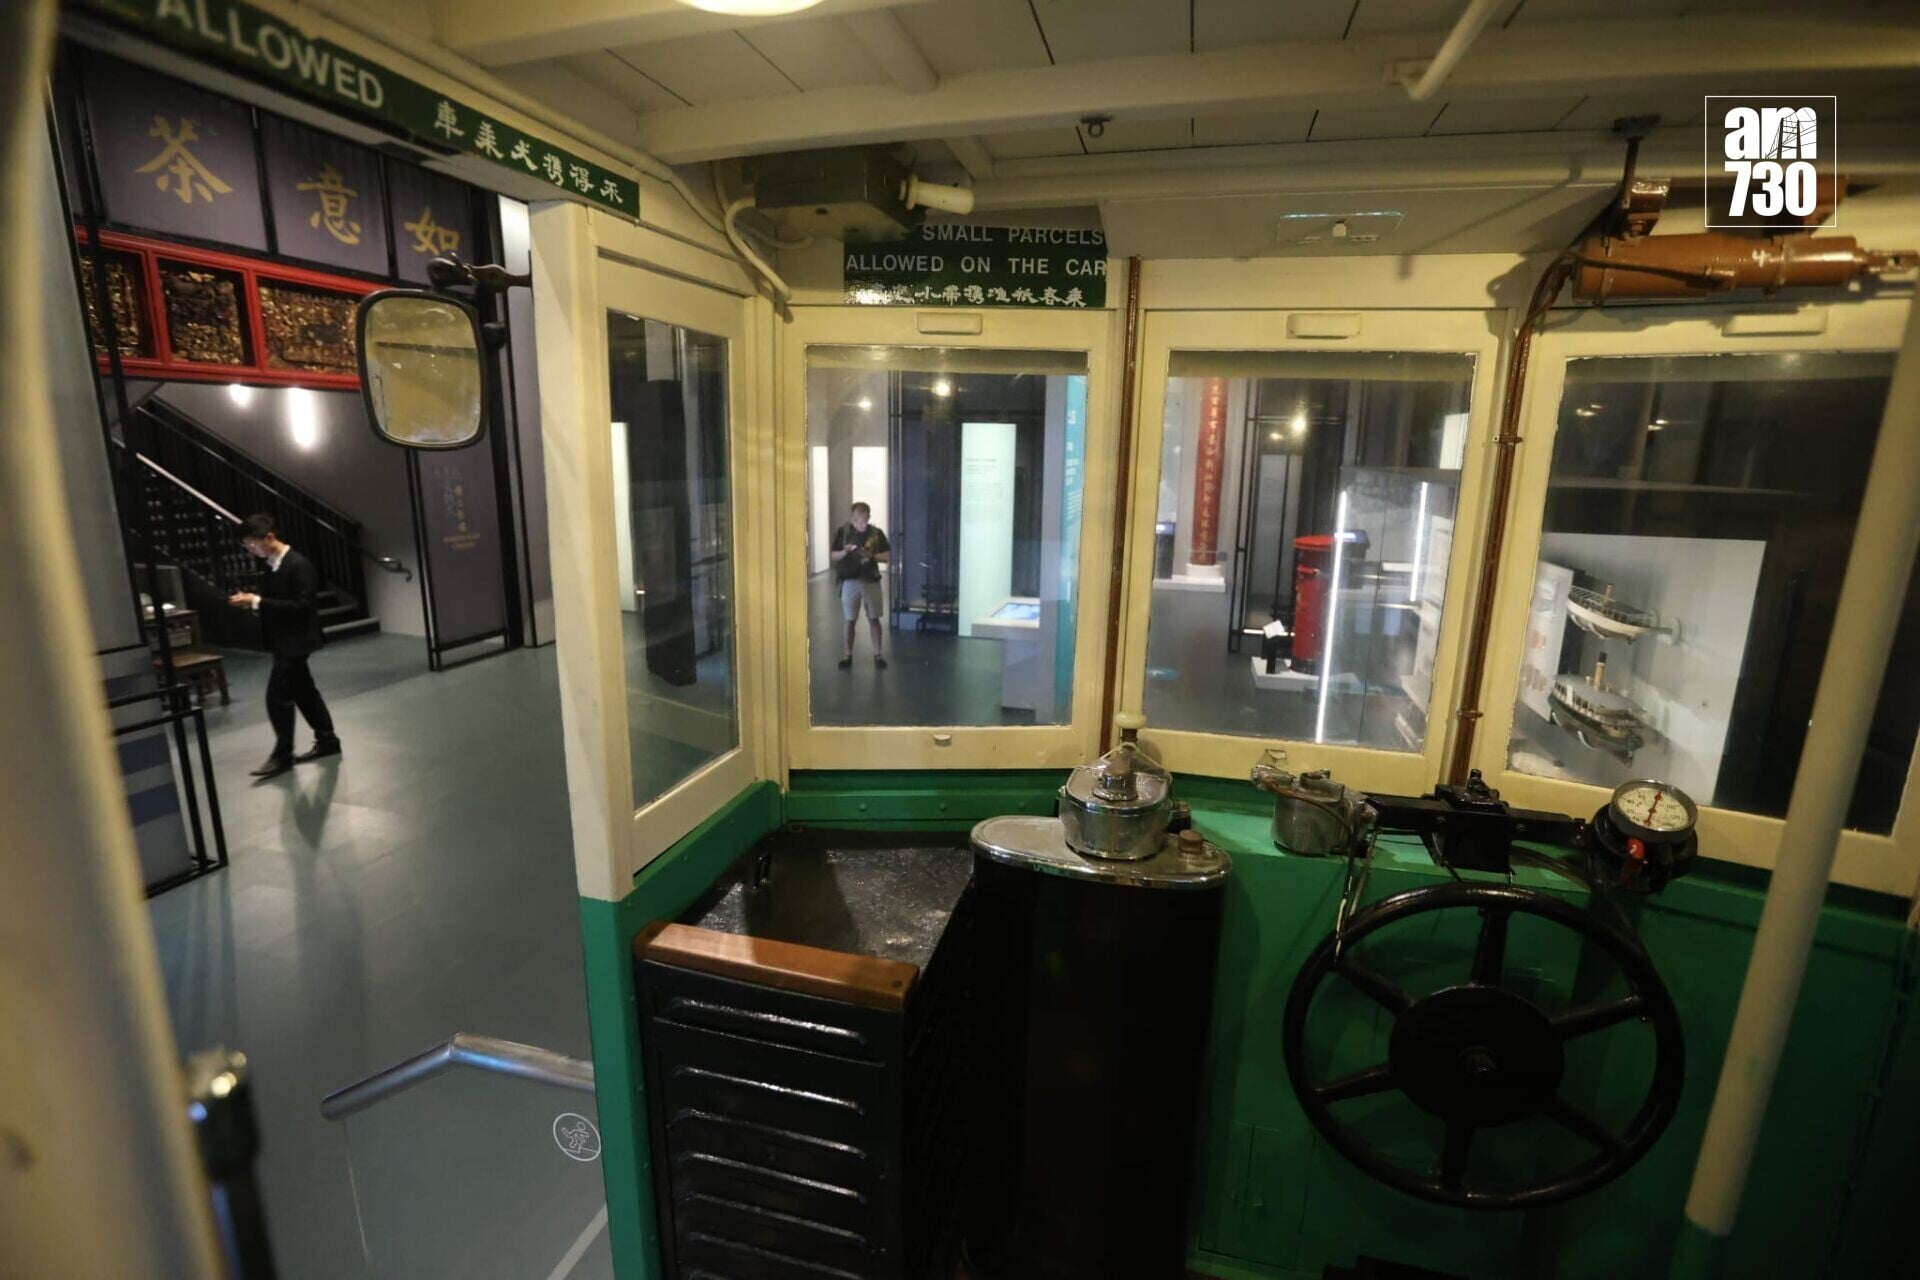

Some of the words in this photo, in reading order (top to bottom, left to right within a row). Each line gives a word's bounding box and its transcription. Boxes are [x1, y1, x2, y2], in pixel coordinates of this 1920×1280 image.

[155, 0, 384, 109] ALLOWED
[922, 224, 993, 242] SMALL
[1008, 228, 1105, 246] PARCELS
[845, 254, 945, 273] ALLOWED
[960, 256, 991, 274] ON
[1008, 257, 1049, 275] THE
[1065, 259, 1107, 276] CAR
